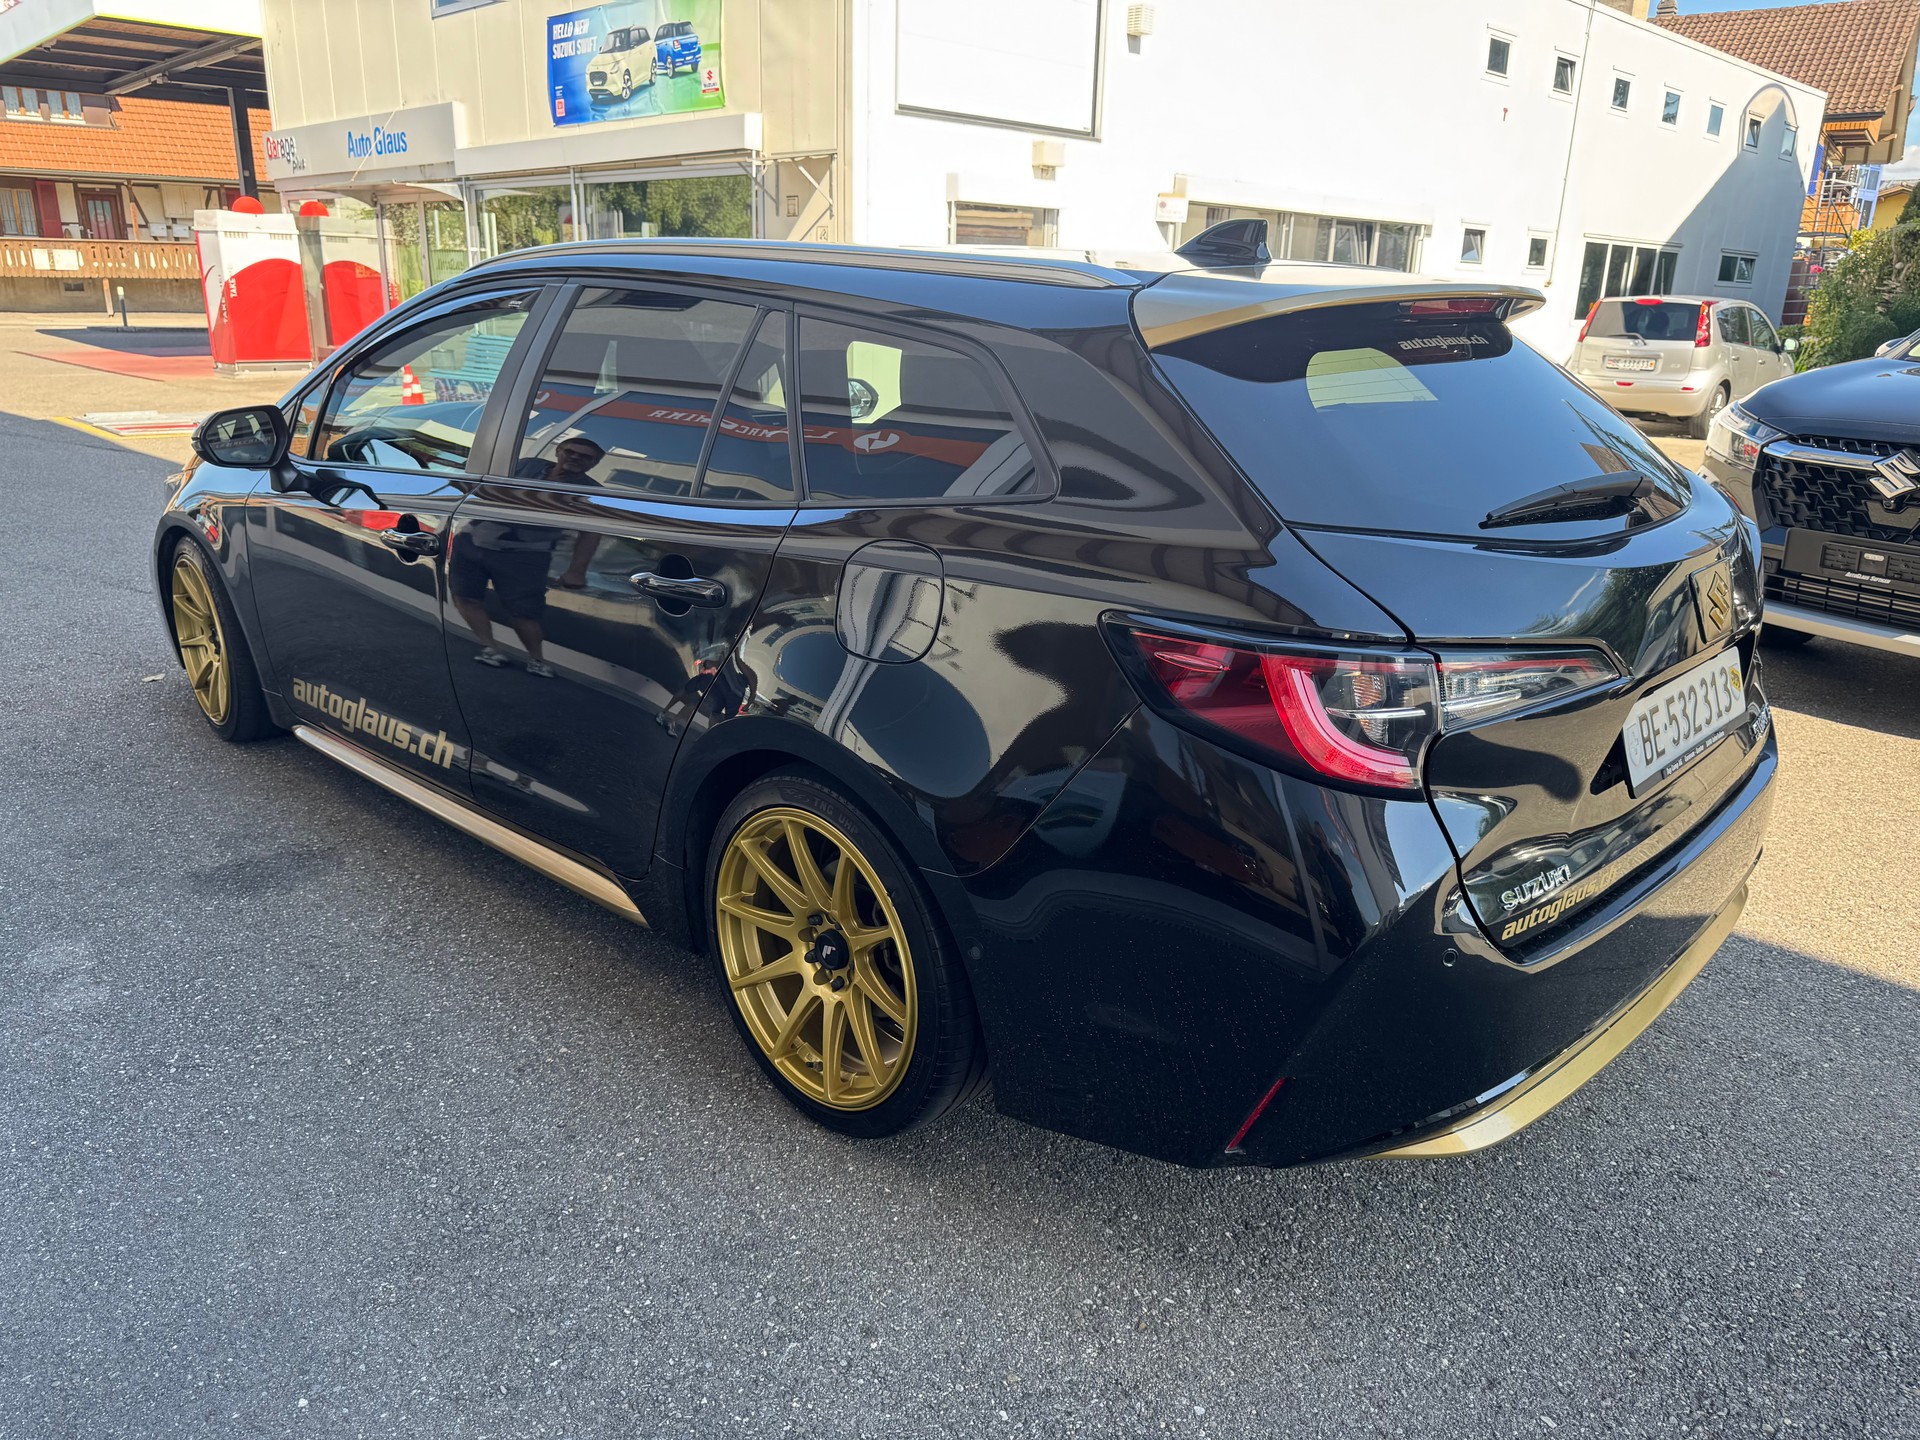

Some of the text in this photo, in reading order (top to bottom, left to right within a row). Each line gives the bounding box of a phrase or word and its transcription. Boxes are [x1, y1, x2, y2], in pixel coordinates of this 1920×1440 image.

[553, 18, 590, 40] HELLO NEW
[552, 35, 598, 60] SUZUKI SWIFT
[347, 126, 408, 158] Auto Glaus
[1397, 334, 1490, 350] autoglaus.ch
[293, 677, 455, 769] autoglaus.ch
[1501, 864, 1571, 911] SUZUKI
[1501, 867, 1617, 941] autoglaus.ch
